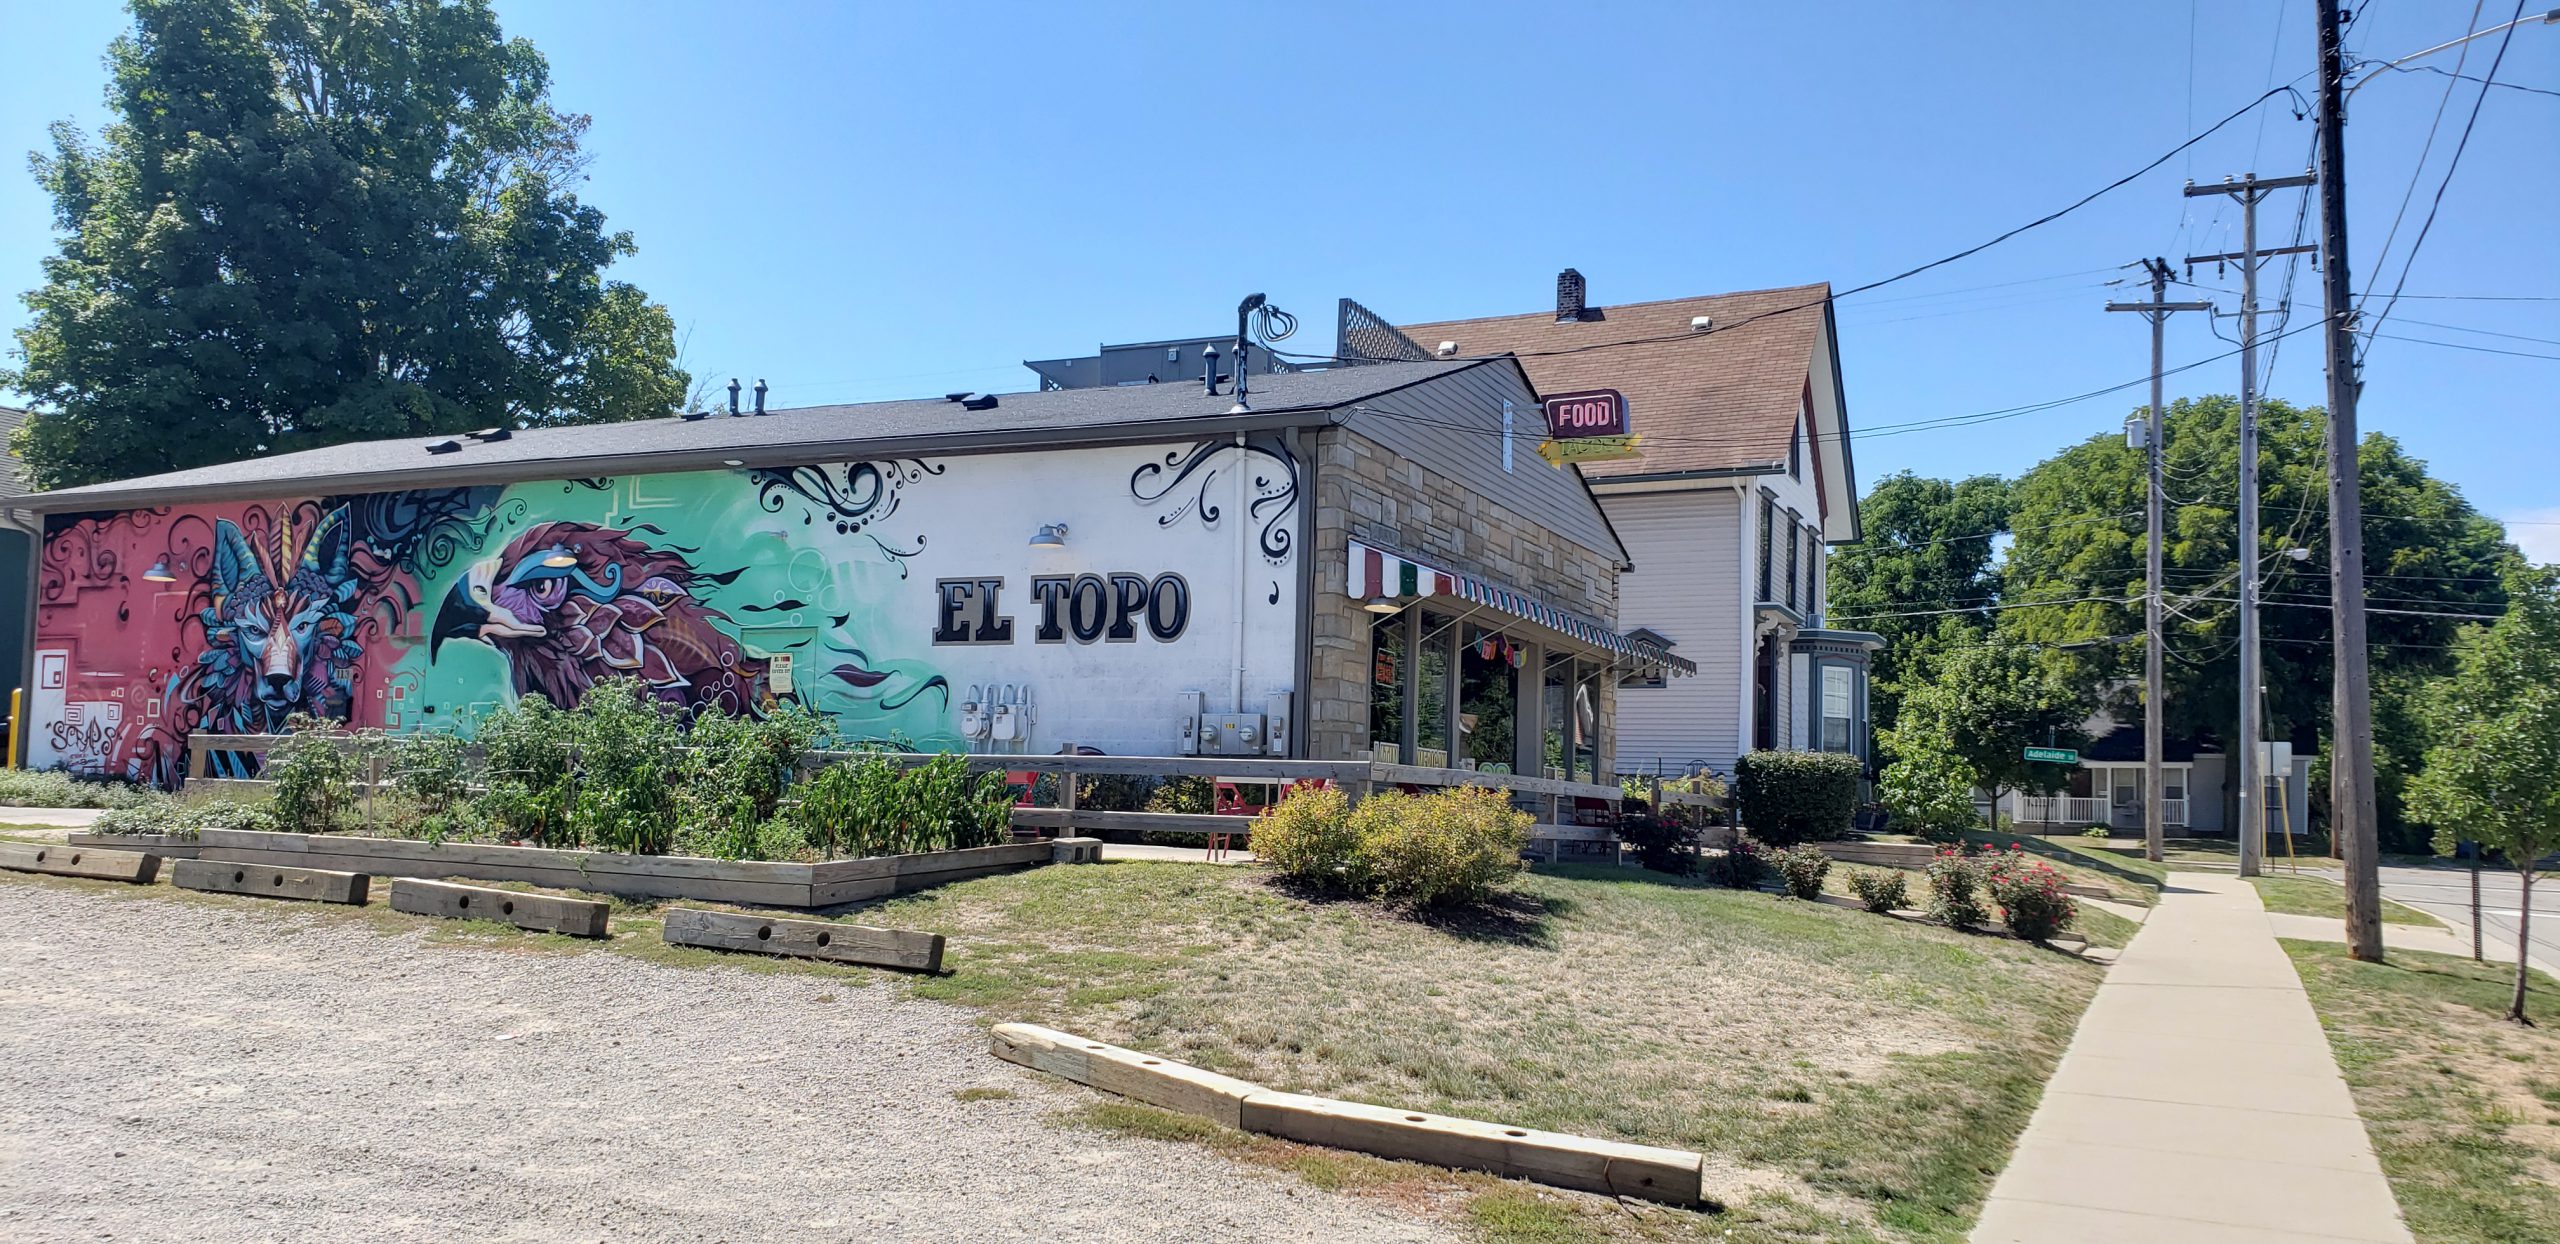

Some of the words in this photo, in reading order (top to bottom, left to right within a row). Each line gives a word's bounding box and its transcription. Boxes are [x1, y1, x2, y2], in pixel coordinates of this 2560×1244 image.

[1559, 401, 1610, 428] FOOD
[932, 576, 1014, 646] EL
[1030, 572, 1191, 645] TOPO
[2028, 750, 2066, 760] Adelaide
